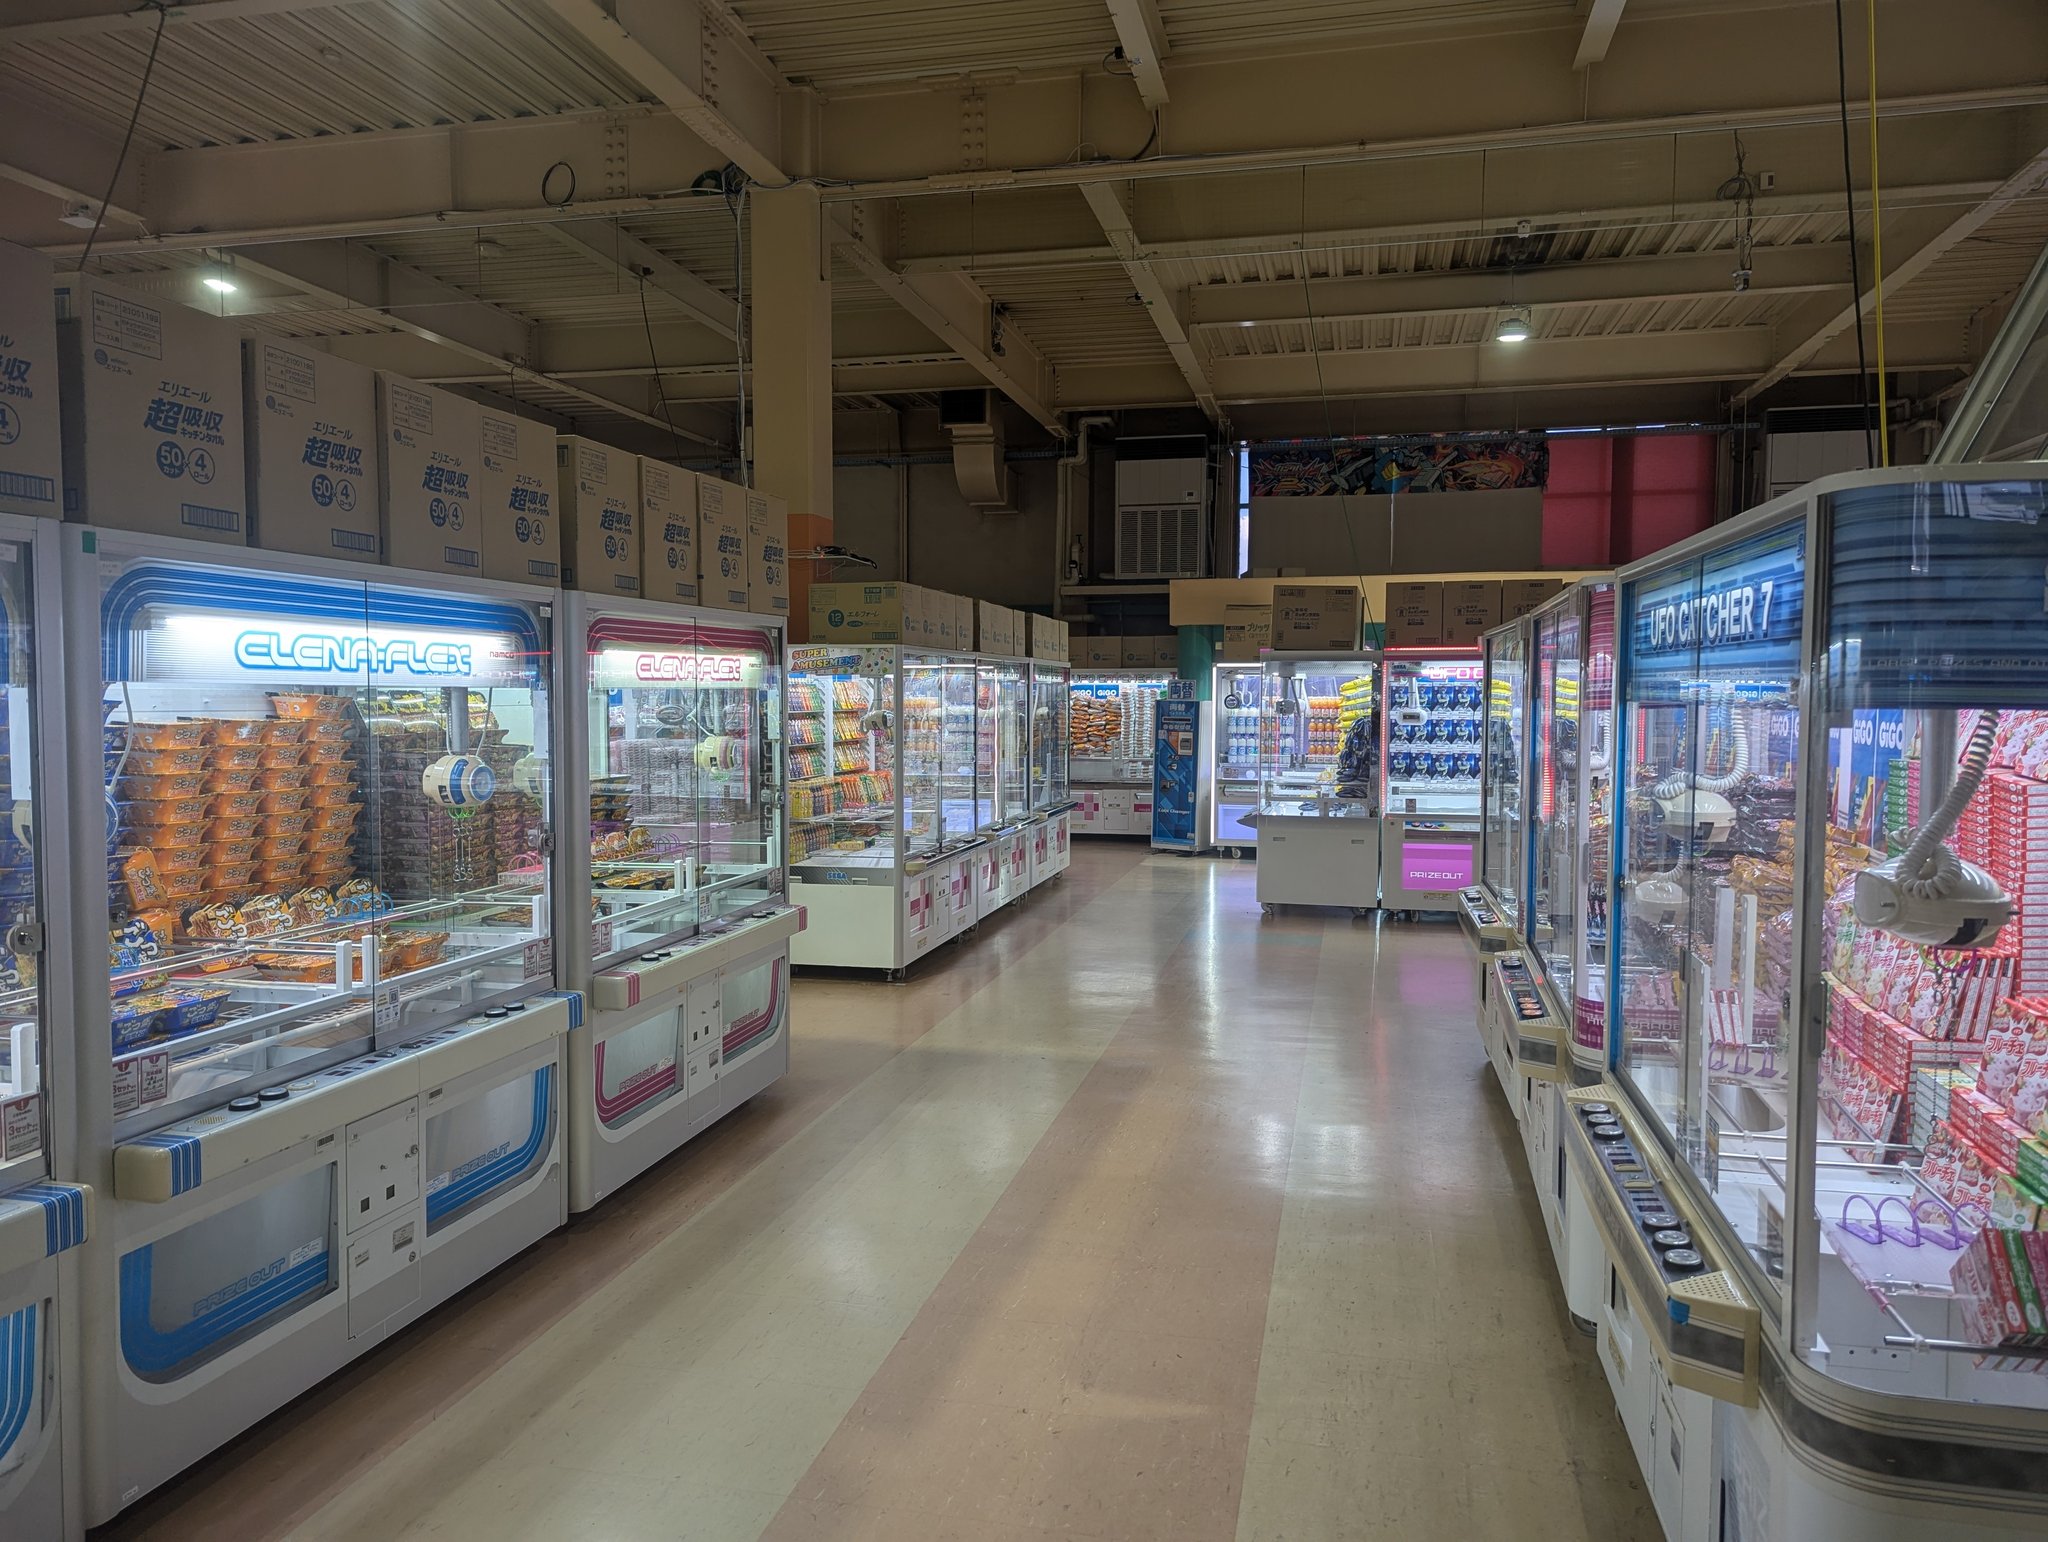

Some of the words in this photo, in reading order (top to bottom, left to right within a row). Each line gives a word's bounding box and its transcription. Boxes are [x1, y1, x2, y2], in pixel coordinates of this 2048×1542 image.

[157, 380, 212, 403] エリエール
[143, 398, 224, 435] 超吸収
[180, 427, 225, 446] キッチンタオル
[312, 421, 353, 440] エリエール
[160, 446, 182, 466] 50
[302, 437, 361, 468] 超吸収
[430, 451, 461, 467] エリエール
[195, 454, 207, 472] 4
[329, 461, 363, 477] キッチンタオル
[193, 470, 210, 480] ロール
[422, 464, 469, 493] 超吸収
[515, 474, 542, 488] エリエール
[314, 478, 331, 496] 50
[340, 484, 349, 500] 4
[339, 500, 353, 508] ロール
[508, 487, 549, 512] 超吸収
[605, 497, 627, 509] エリエール
[431, 501, 445, 517] 50
[451, 506, 459, 520] 4
[517, 520, 528, 534] 50
[600, 508, 631, 530] 超吸収
[534, 525, 541, 537] 4
[664, 522, 690, 543] 超吸収
[620, 541, 625, 552] 4
[718, 534, 741, 553] 超吸収
[830, 612, 842, 622] 12
[1650, 604, 1675, 647] UFO
[1679, 586, 1754, 643] CATCHER
[1761, 580, 1774, 631] 7
[489, 650, 515, 659] namco
[792, 647, 828, 660] SUPER
[791, 656, 863, 671] AMUSEMENT
[1170, 681, 1193, 699] 両替
[1987, 1035, 2026, 1055] フルーチェ
[451, 1154, 486, 1182] PRIZE
[486, 1142, 510, 1161] OUT
[1923, 1161, 1956, 1183] フルーチェ
[1954, 1190, 1992, 1214] フルーチェ
[193, 1277, 247, 1316] PRIZE
[248, 1258, 285, 1288] OUT
